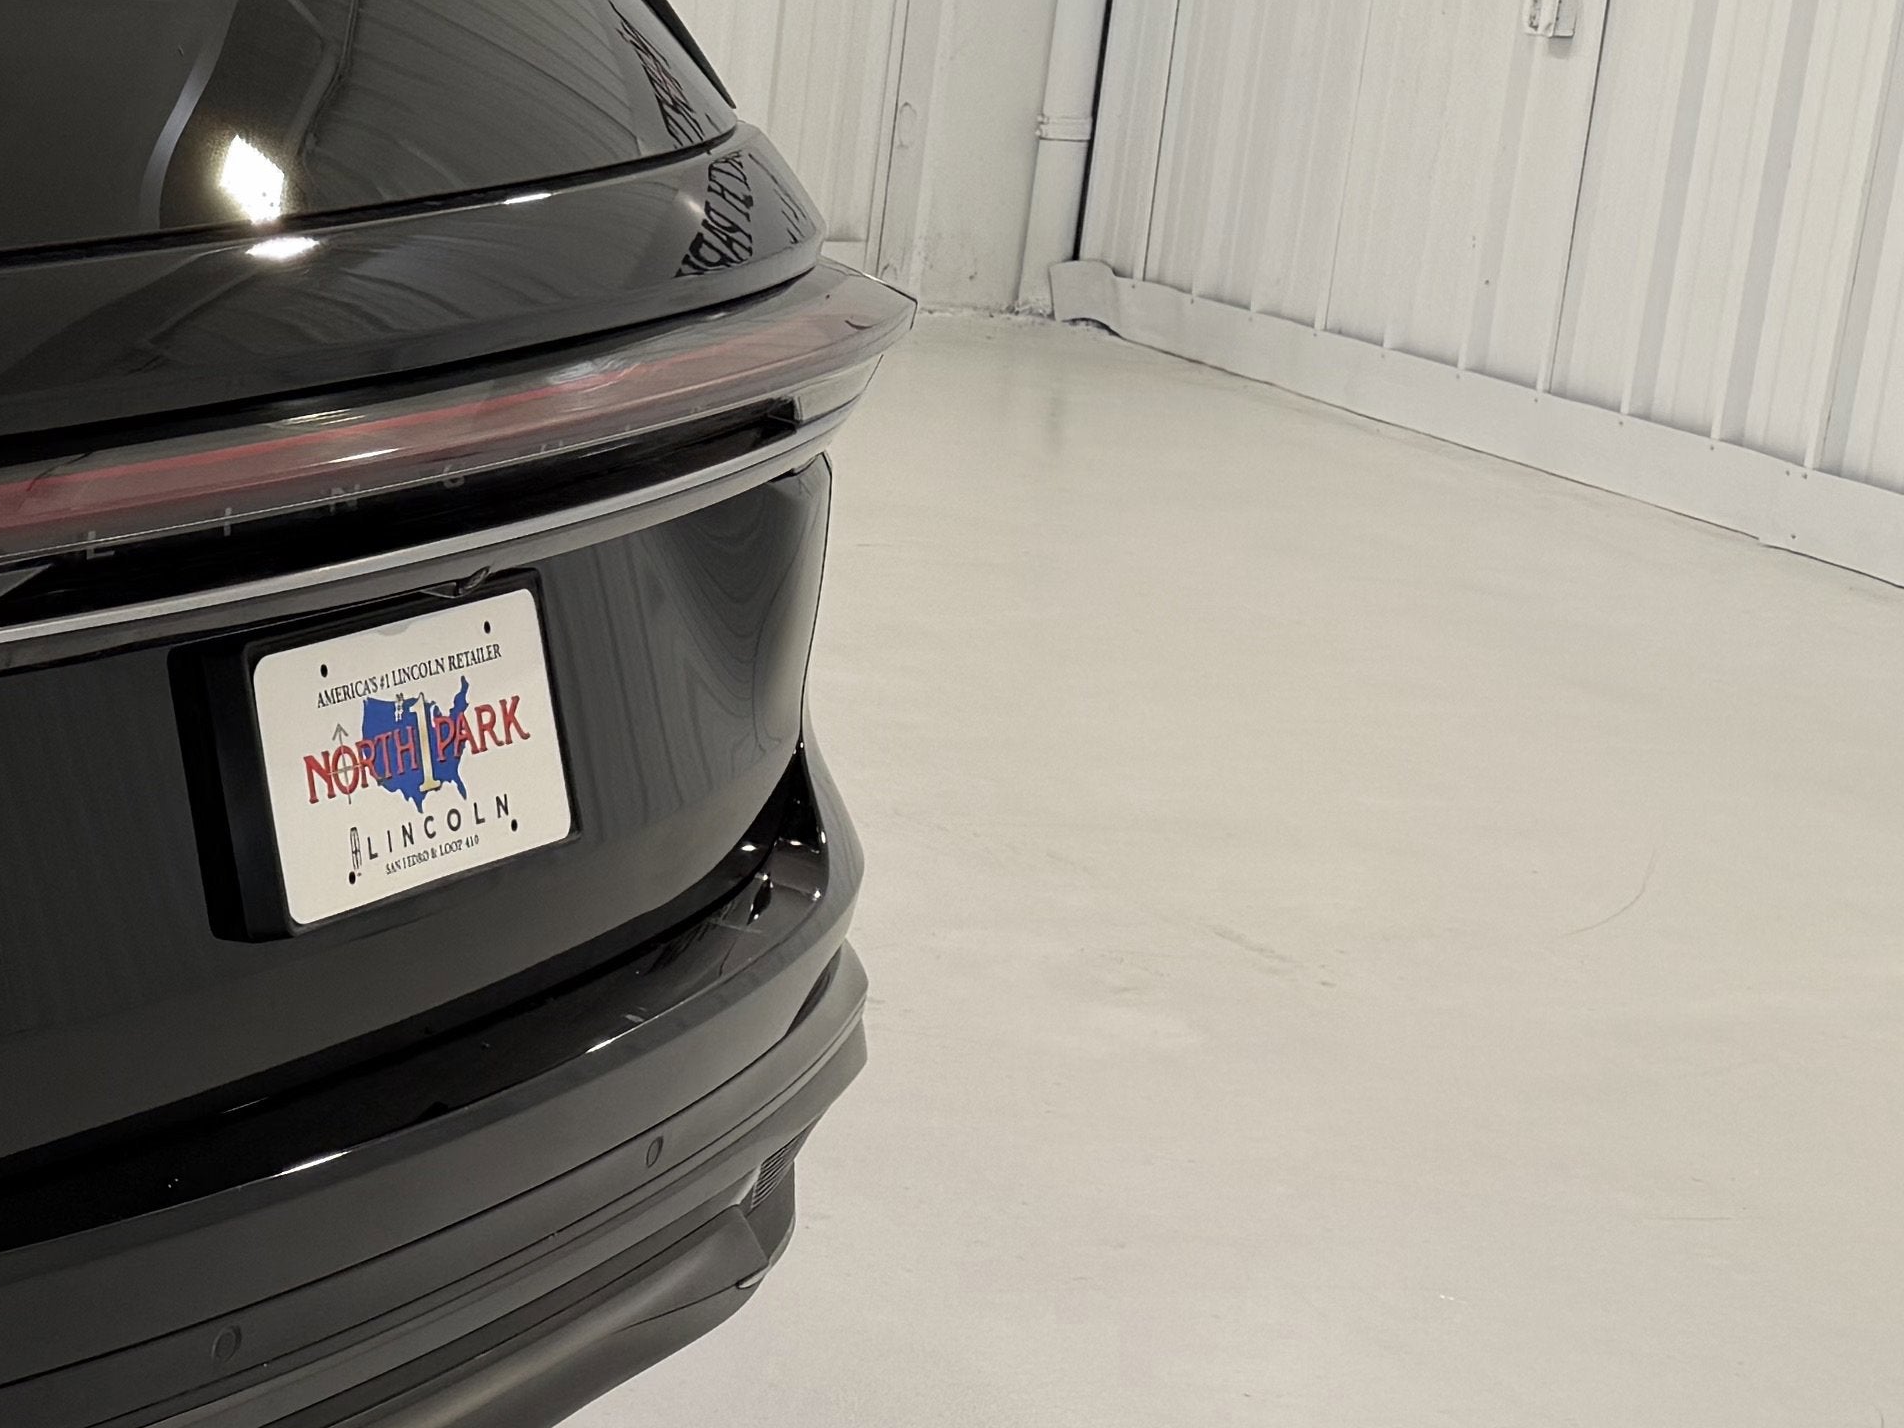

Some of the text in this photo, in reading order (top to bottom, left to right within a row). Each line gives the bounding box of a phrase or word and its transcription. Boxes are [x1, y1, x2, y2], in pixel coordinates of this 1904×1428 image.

[379, 673, 390, 690] #1
[392, 658, 445, 686] LINCOLN
[448, 643, 503, 671] RETAILER
[303, 725, 419, 804] NORTH
[432, 695, 531, 762] PARK
[367, 793, 509, 860] LINCOLN
